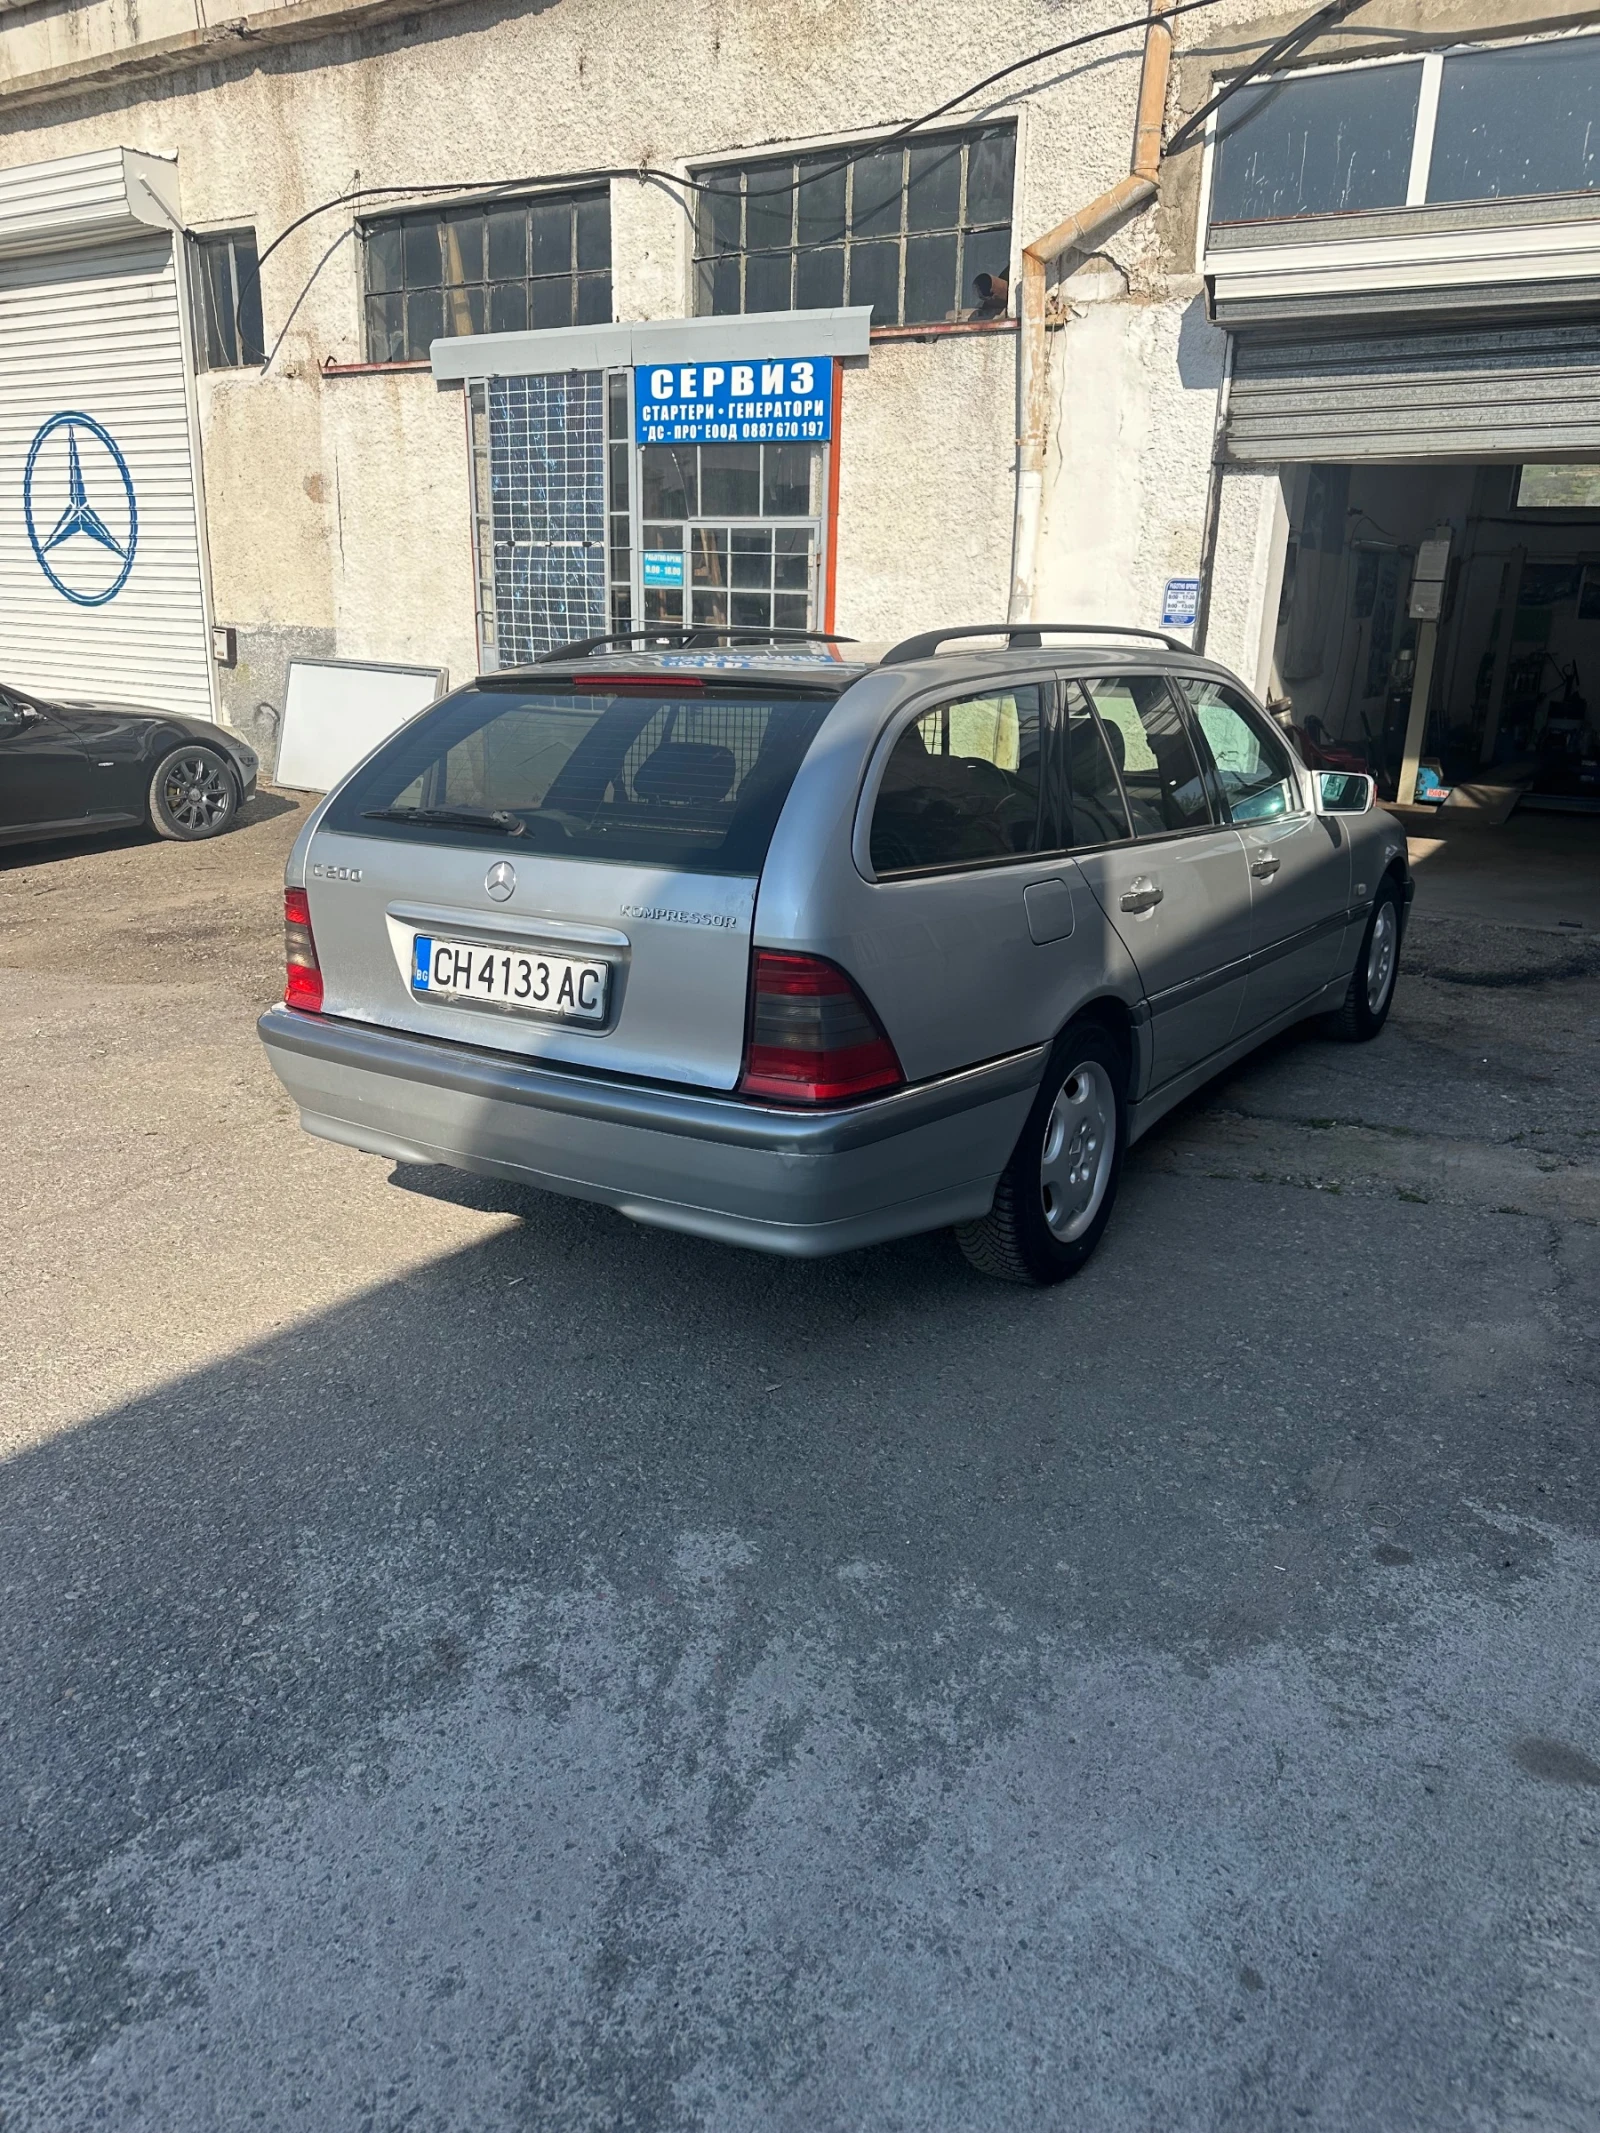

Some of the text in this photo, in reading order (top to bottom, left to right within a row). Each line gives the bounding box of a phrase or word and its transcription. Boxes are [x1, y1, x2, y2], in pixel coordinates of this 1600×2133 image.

[651, 362, 814, 400] СЕРВИЗ
[642, 400, 824, 422] СТАРТЕРИ ГЕНЕРАТОРИ
[705, 423, 737, 440] ЕООД
[742, 422, 773, 438] 0887
[776, 421, 798, 437] 670
[802, 421, 824, 437] 197
[313, 863, 363, 882] C 200
[620, 904, 737, 928] KOMPRESSOR
[416, 969, 429, 982] BG
[478, 955, 550, 1001] 4133
